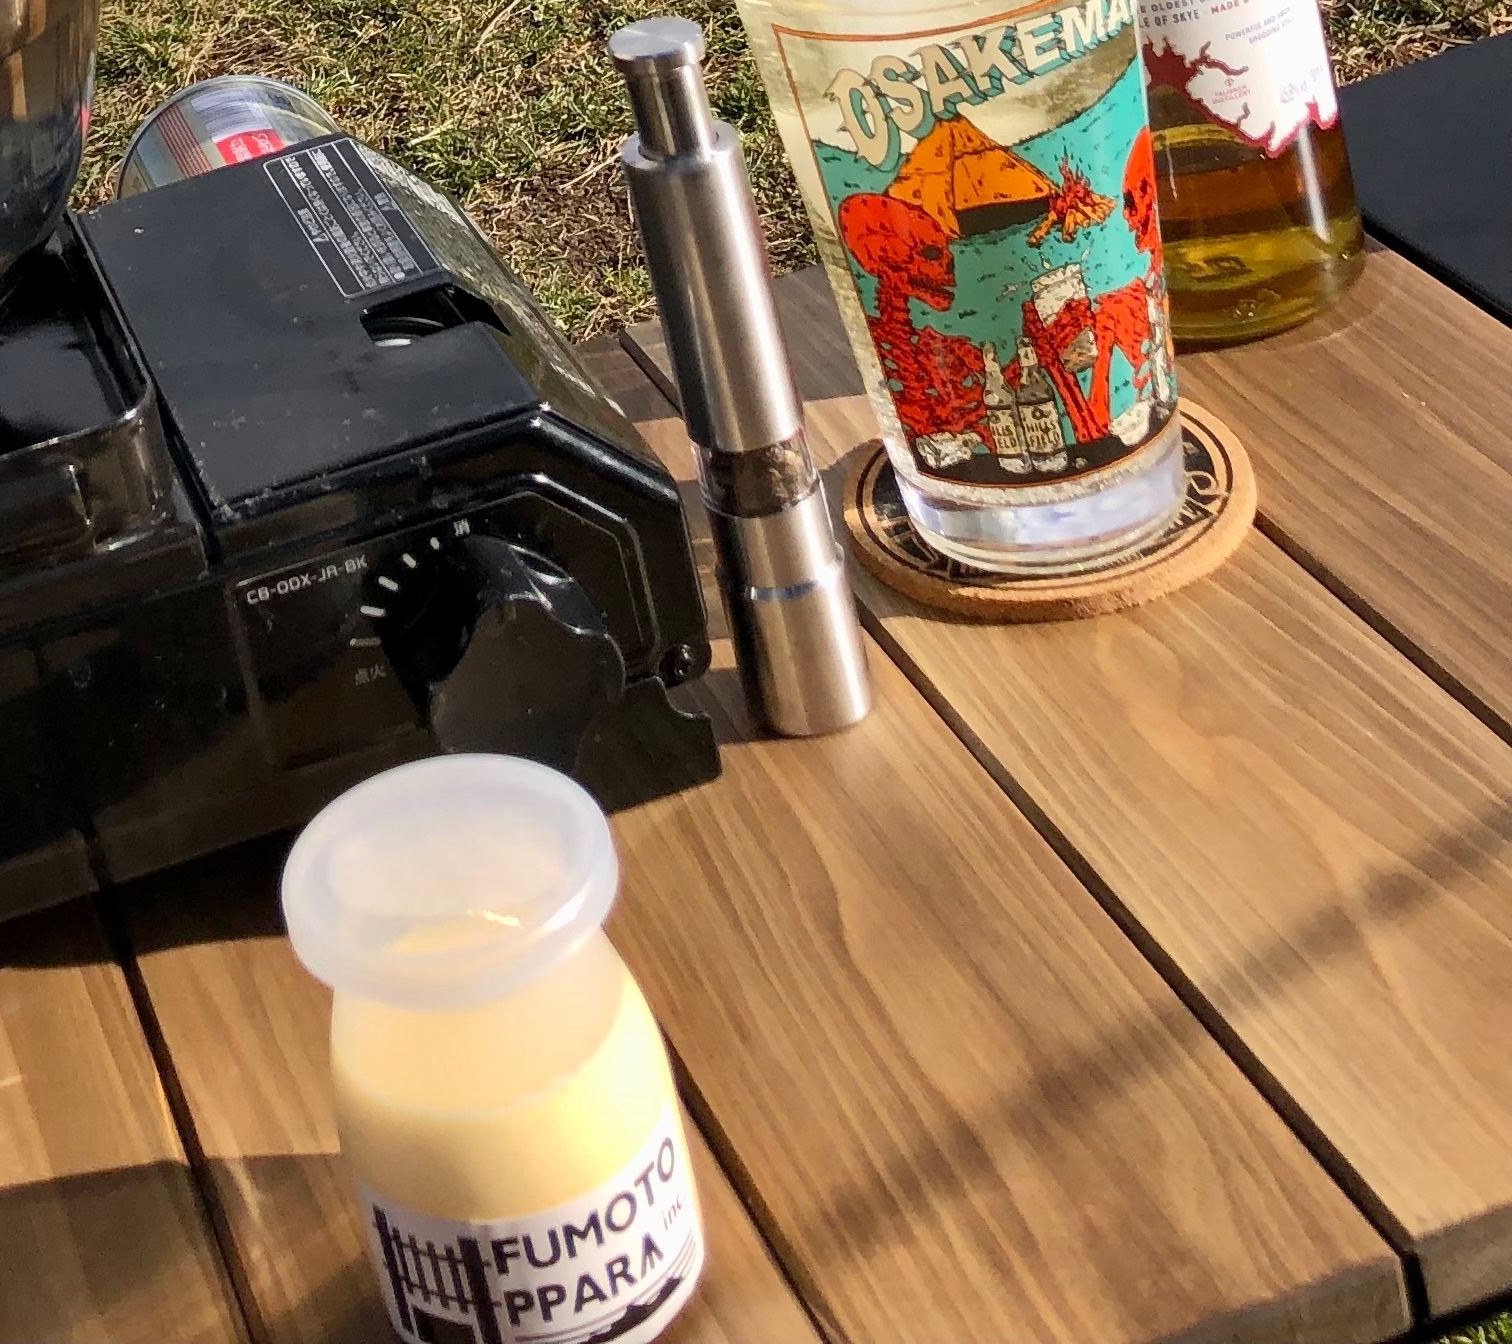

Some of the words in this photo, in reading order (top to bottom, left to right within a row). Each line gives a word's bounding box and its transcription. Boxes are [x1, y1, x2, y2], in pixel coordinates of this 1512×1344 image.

[1153, 14, 1169, 27] OF
[1172, 8, 1200, 24] SKYE
[490, 1136, 676, 1277] FUMOTO
[502, 1231, 665, 1329] PPARA
